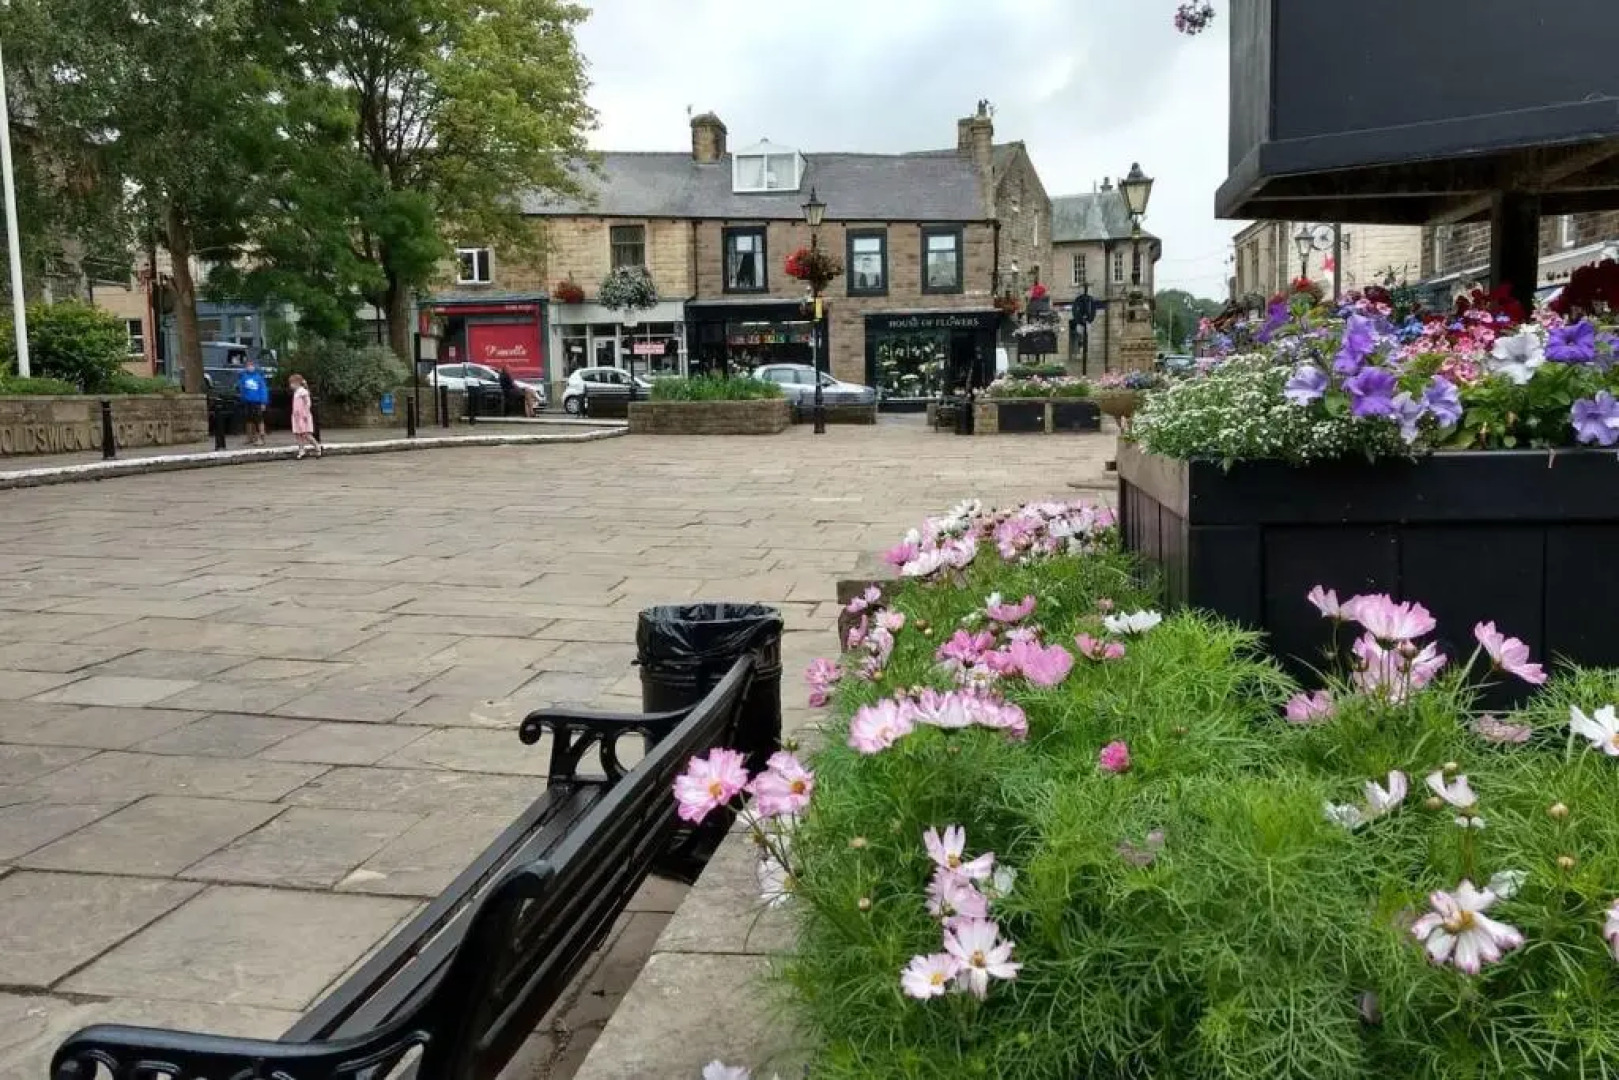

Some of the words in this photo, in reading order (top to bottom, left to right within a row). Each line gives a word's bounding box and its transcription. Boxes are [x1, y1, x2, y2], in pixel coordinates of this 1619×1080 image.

[889, 317, 918, 328] HOUSE
[921, 318, 932, 328] OF
[935, 316, 979, 327] FLOWERS
[0, 423, 91, 454] OLDSWICK
